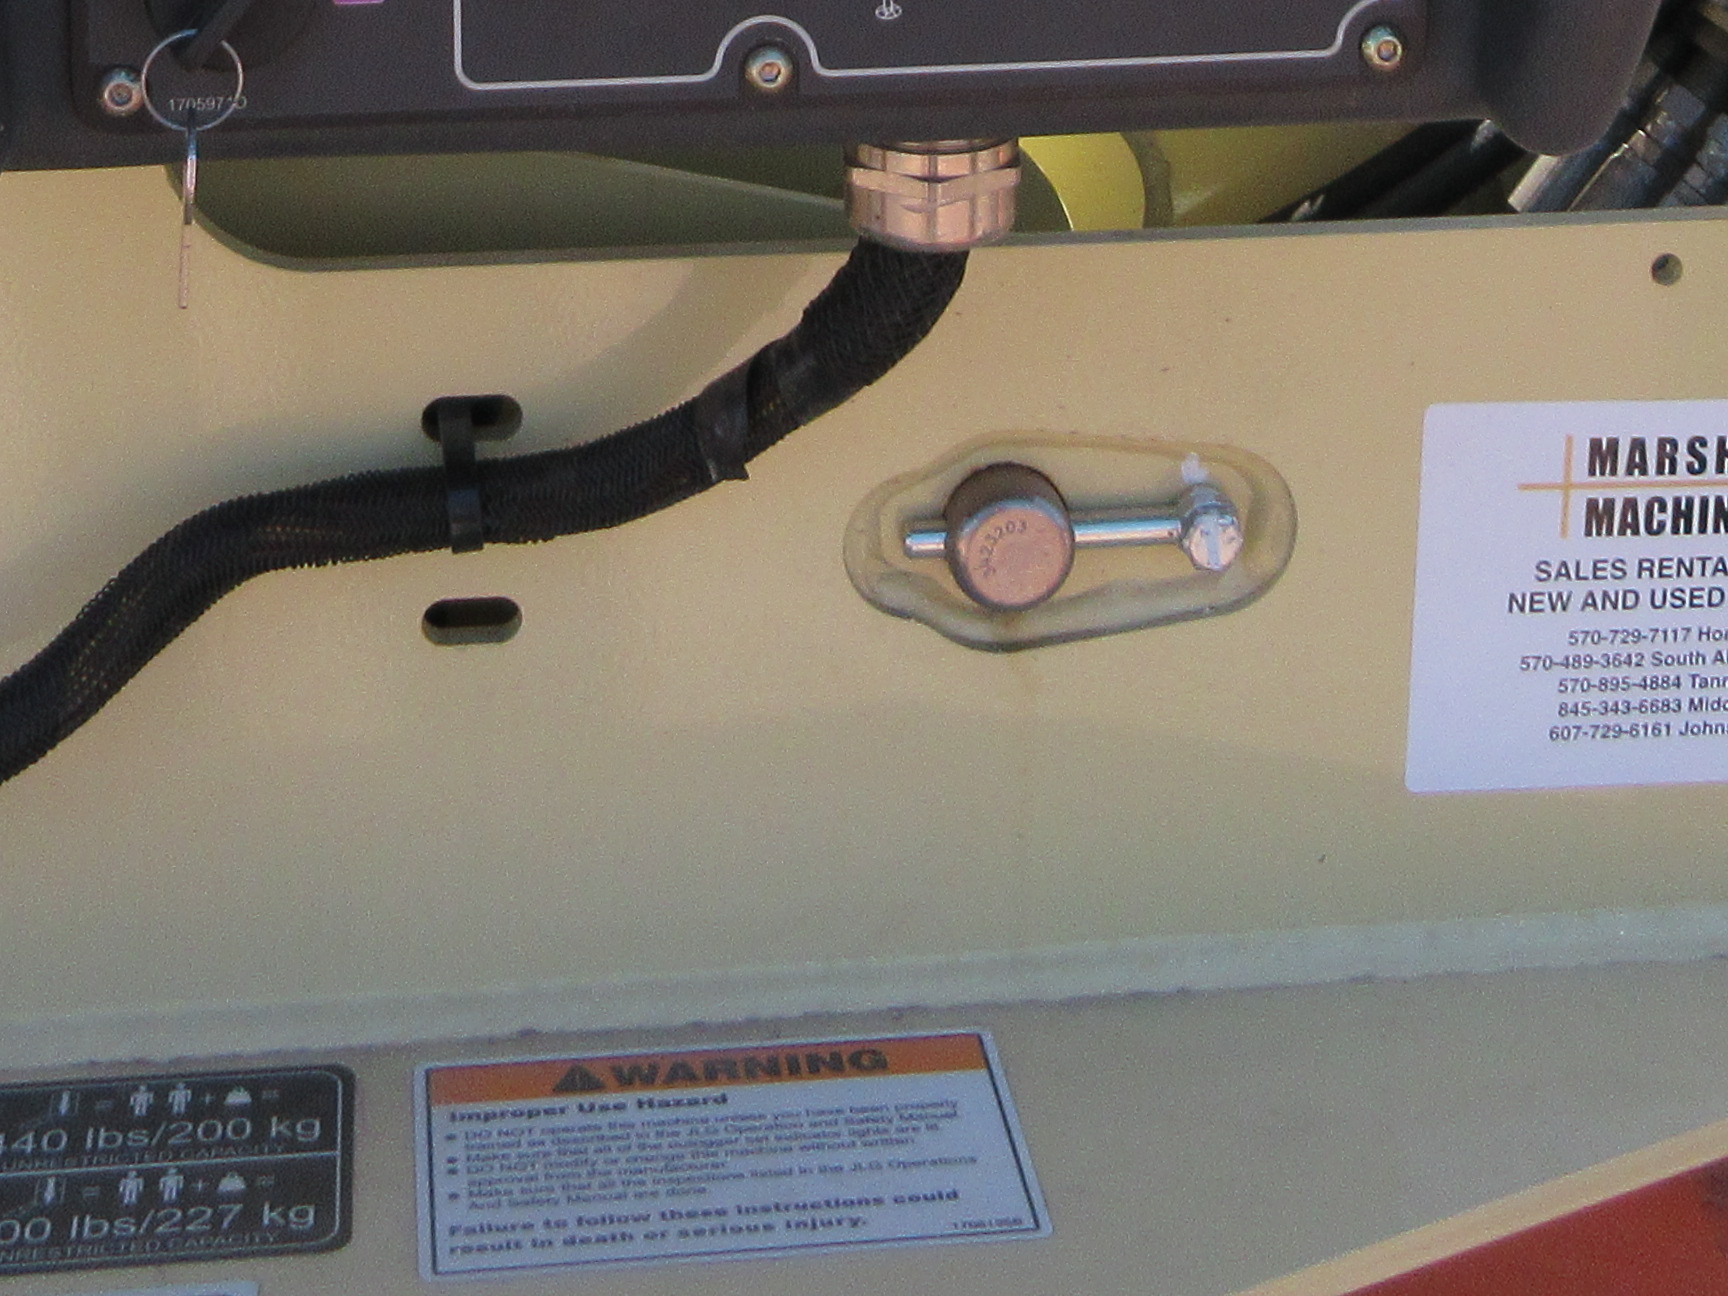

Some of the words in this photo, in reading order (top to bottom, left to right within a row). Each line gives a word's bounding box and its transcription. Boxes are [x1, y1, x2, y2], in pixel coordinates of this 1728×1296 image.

[1535, 559, 1628, 582] SALES
[1507, 591, 1573, 613] NEW
[1580, 589, 1641, 612] AND
[1649, 586, 1725, 609] USED
[1568, 627, 1692, 646] 570-729-7117
[1650, 650, 1706, 667] South
[611, 1048, 889, 1087] WARNING
[450, 1106, 568, 1123] Improper
[578, 1101, 627, 1114] Use
[637, 1092, 728, 1109] Hazard
[86, 1117, 253, 1152] lbs/200
[271, 1114, 322, 1144] kg
[68, 1206, 245, 1239] lbs/227
[262, 1201, 316, 1230] kg
[450, 1219, 535, 1237] Failure
[543, 1217, 568, 1229] to
[576, 1211, 651, 1227] follow
[736, 1194, 885, 1216] instructions
[893, 1188, 960, 1205] could
[450, 1239, 522, 1255] result
[531, 1237, 553, 1248] in
[562, 1231, 633, 1246] death
[677, 1221, 775, 1239] serious
